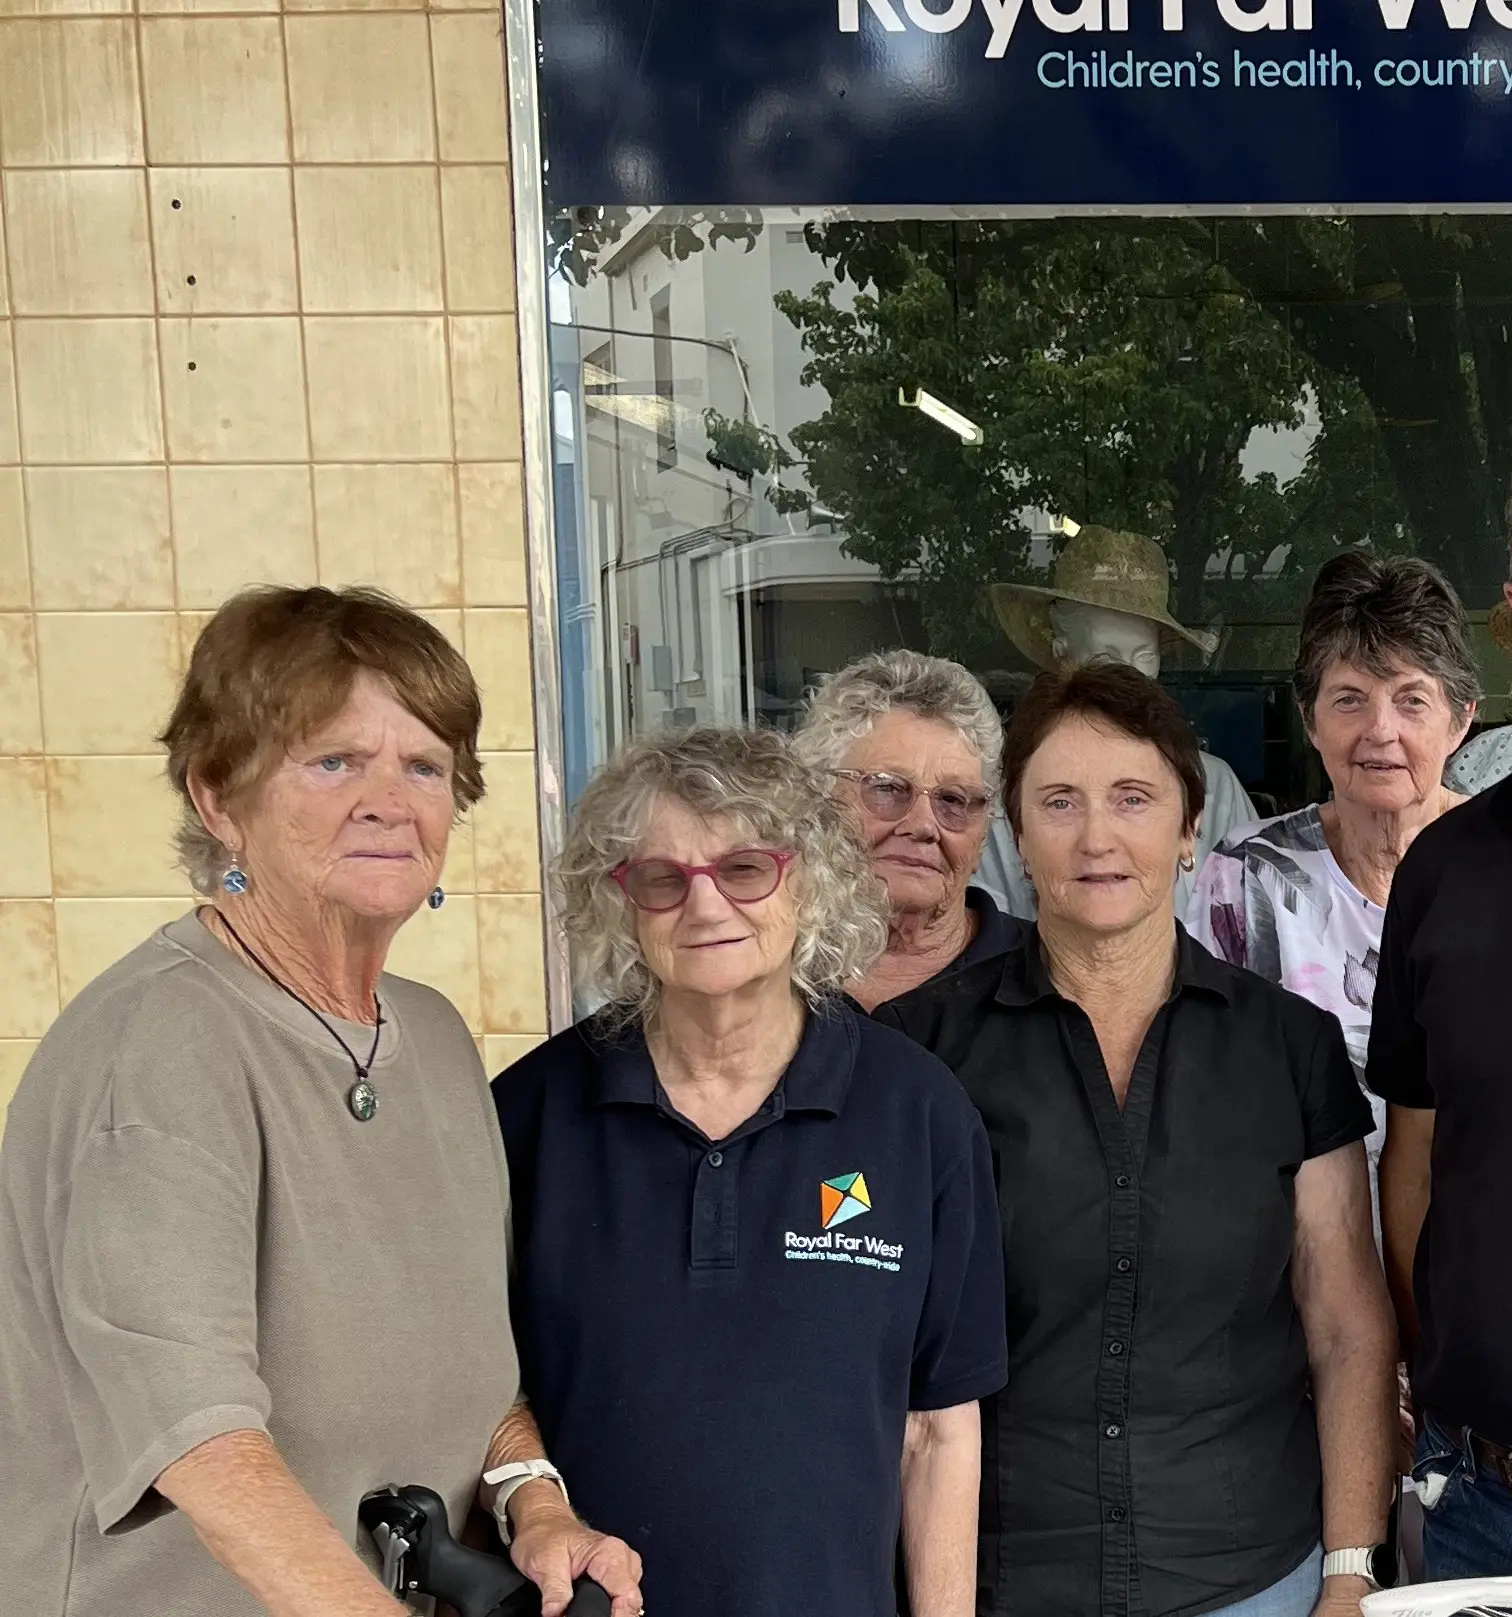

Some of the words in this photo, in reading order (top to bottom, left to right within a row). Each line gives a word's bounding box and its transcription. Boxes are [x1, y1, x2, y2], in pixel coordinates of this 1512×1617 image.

[1037, 50, 1220, 88] Children's
[1234, 48, 1362, 90] health,
[785, 1231, 832, 1251] Royal
[835, 1233, 863, 1250] Far
[864, 1235, 904, 1258] West
